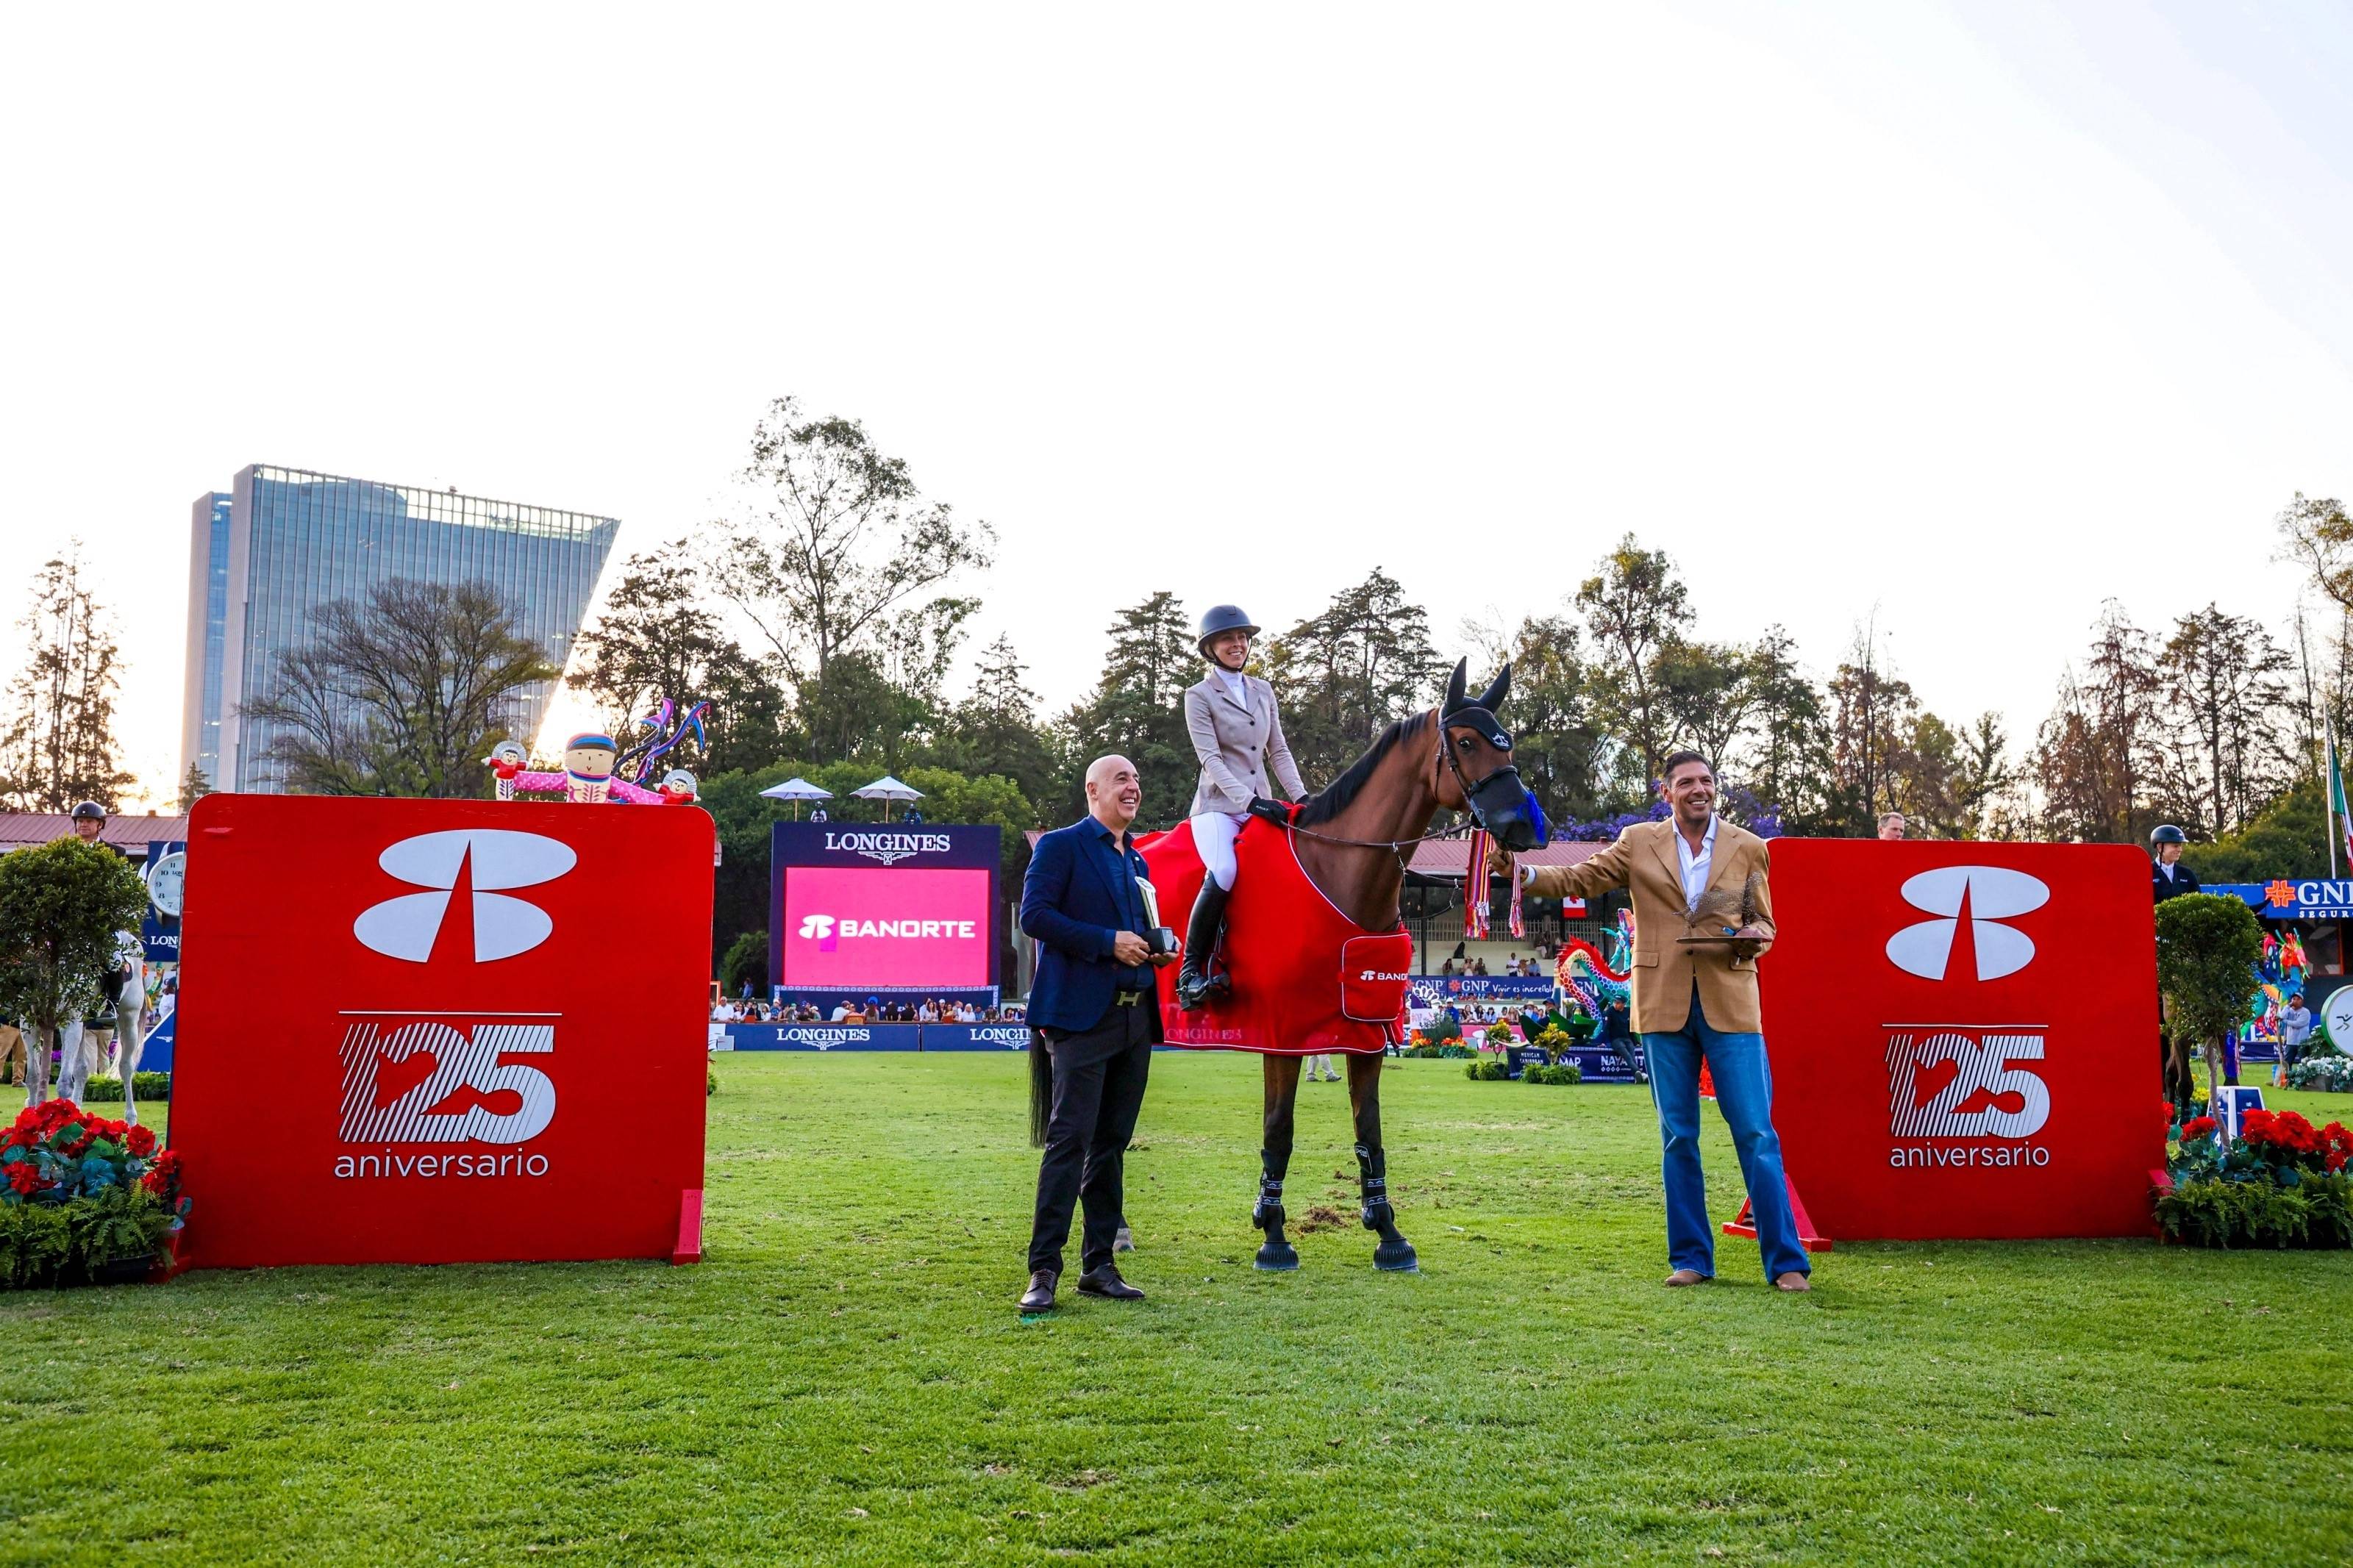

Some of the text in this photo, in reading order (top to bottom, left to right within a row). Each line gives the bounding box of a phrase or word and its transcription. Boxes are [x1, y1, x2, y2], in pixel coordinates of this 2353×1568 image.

[825, 832, 951, 852] LONGINES
[2299, 910, 2353, 918] SEGUR
[840, 920, 976, 938] BANORTE
[151, 936, 179, 945] LON
[1461, 980, 1490, 992] GNP
[1493, 984, 1511, 992] Vivir
[776, 1028, 871, 1041] LONGINES
[1601, 1056, 1644, 1066] NAYAIT
[339, 1023, 557, 1145] 125
[1885, 1034, 2051, 1139] 125
[1890, 1141, 2050, 1167] aniversario
[334, 1148, 549, 1178] aniversario
